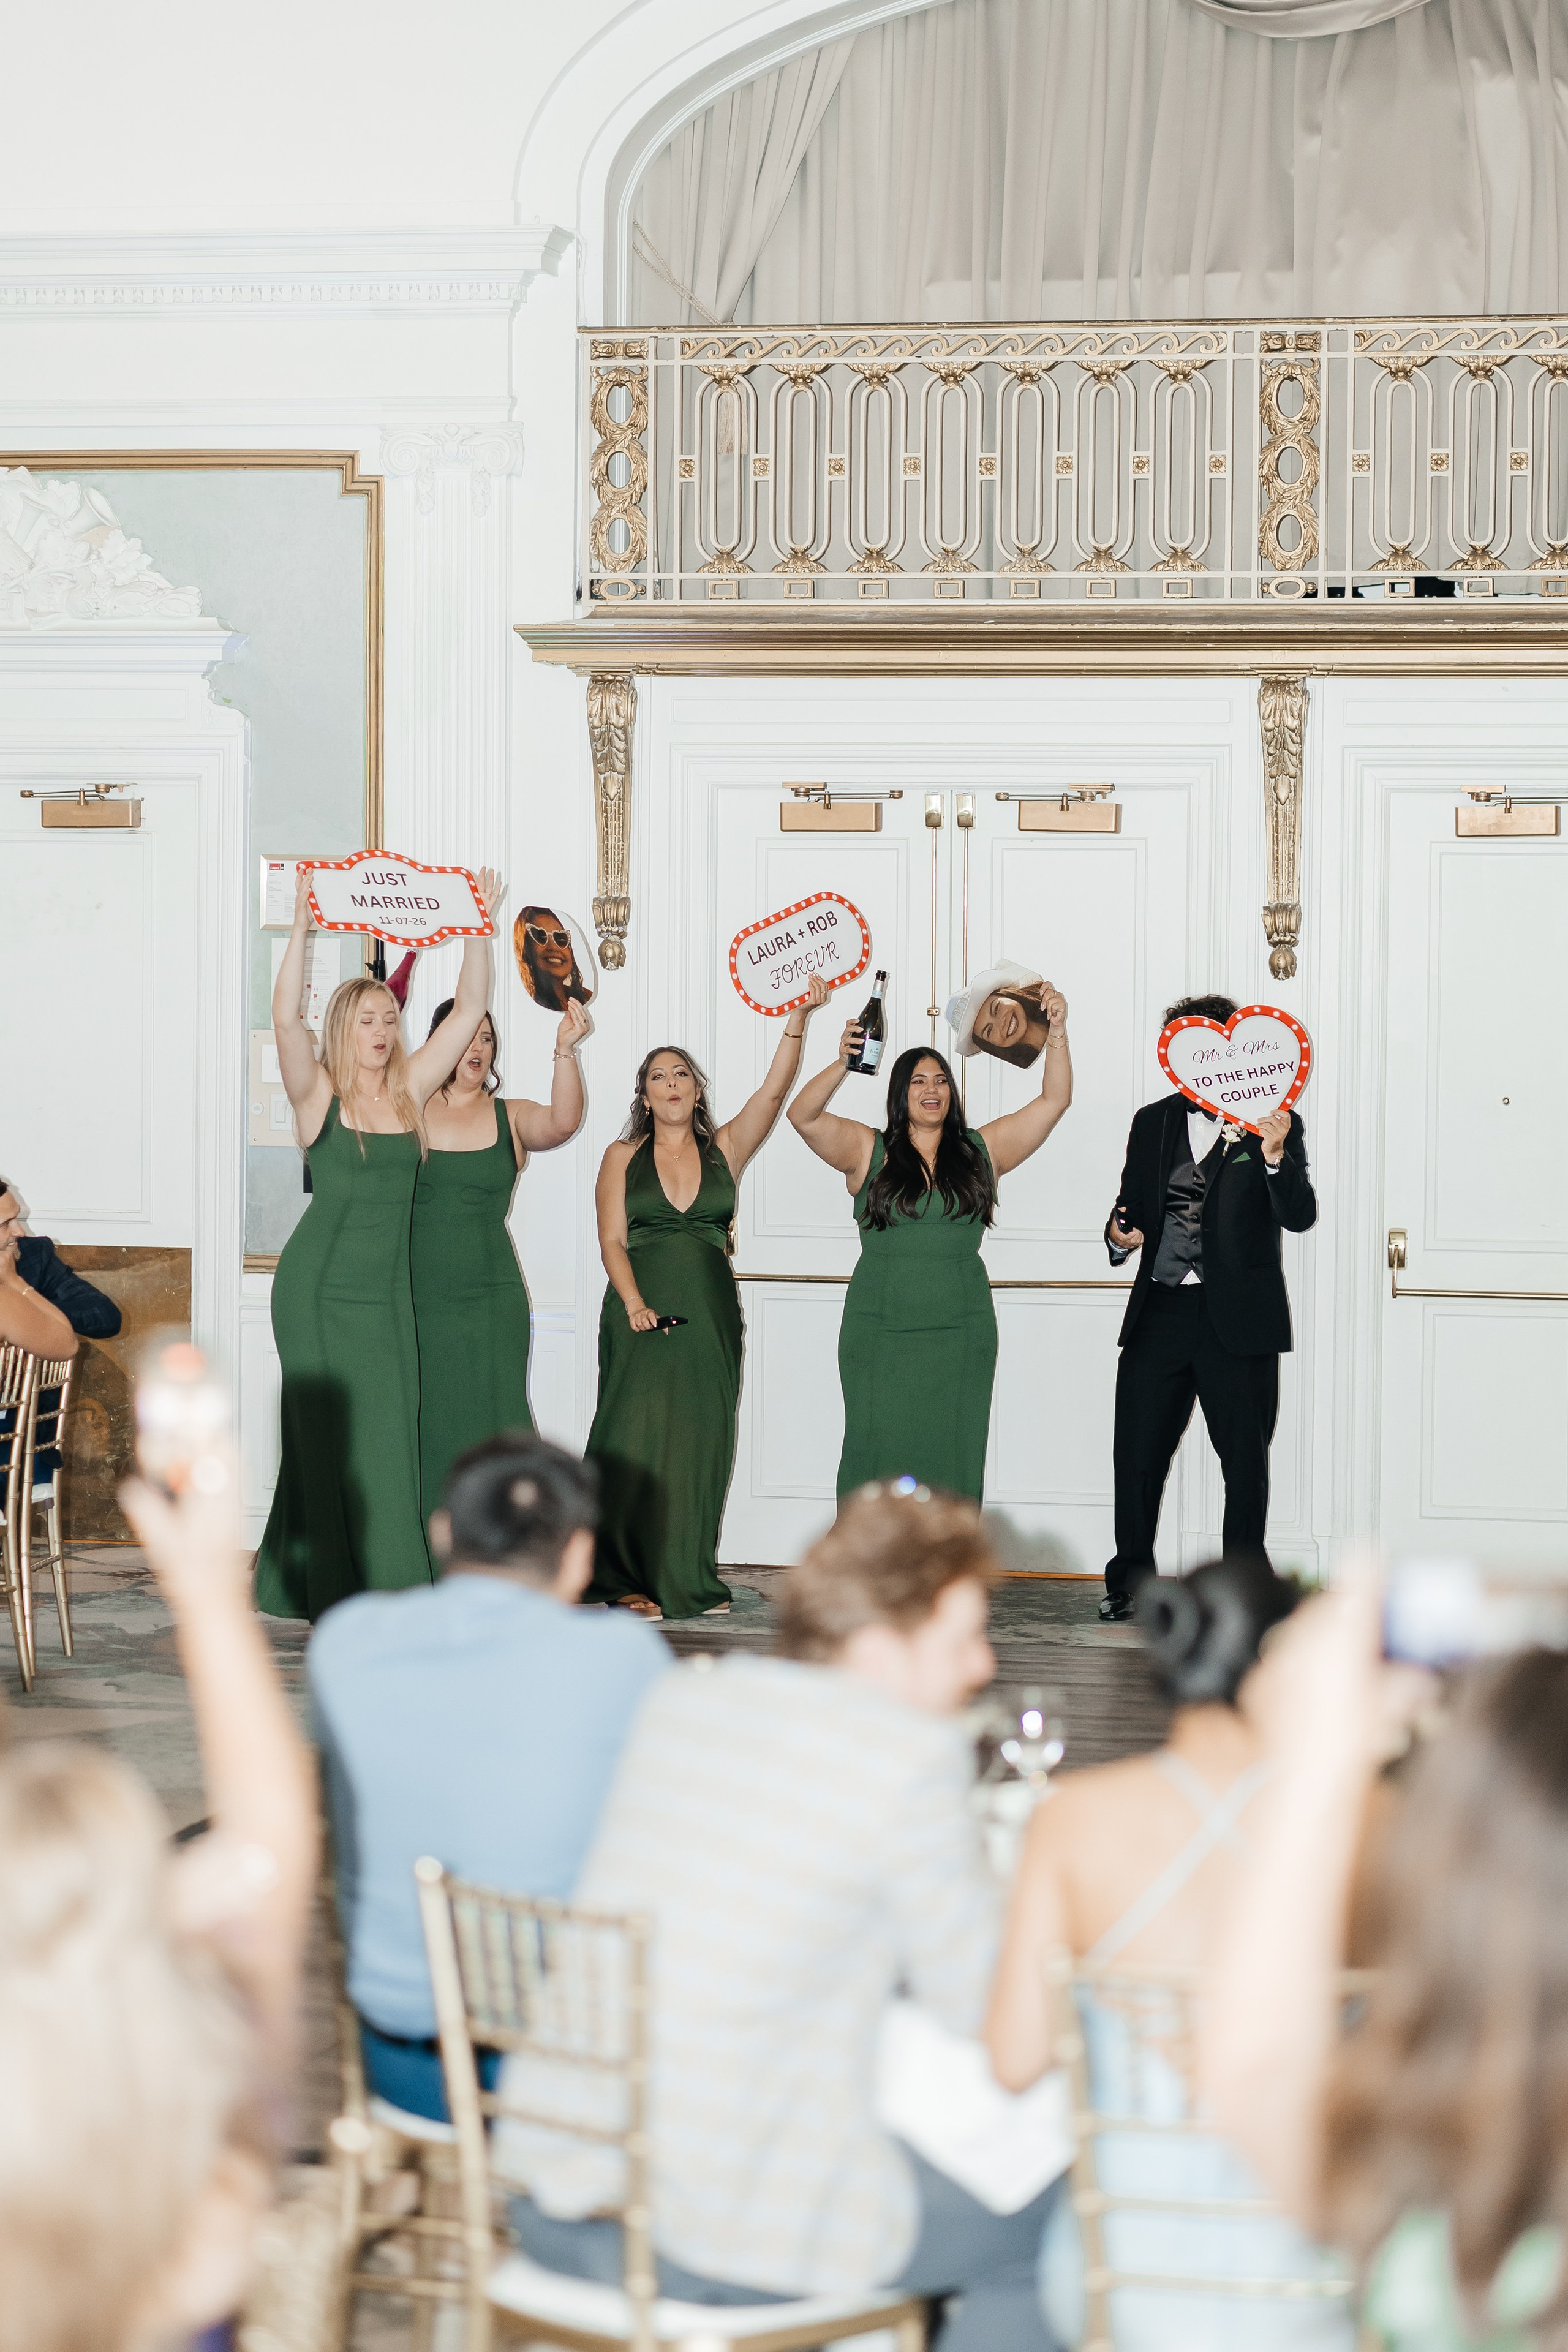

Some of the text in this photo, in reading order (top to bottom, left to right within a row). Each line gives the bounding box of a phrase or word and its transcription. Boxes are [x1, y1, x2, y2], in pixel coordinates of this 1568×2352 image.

[361, 872, 407, 886] JUST
[350, 894, 440, 910] MARRIED
[378, 916, 427, 925] 11-07-26
[747, 911, 839, 966] LAURA + ROB
[769, 941, 840, 990] FOREVR
[1192, 1039, 1281, 1064] Mr & Mrs
[1192, 1061, 1295, 1088] TO THE HAPPY
[1221, 1084, 1280, 1103] COUPLE
